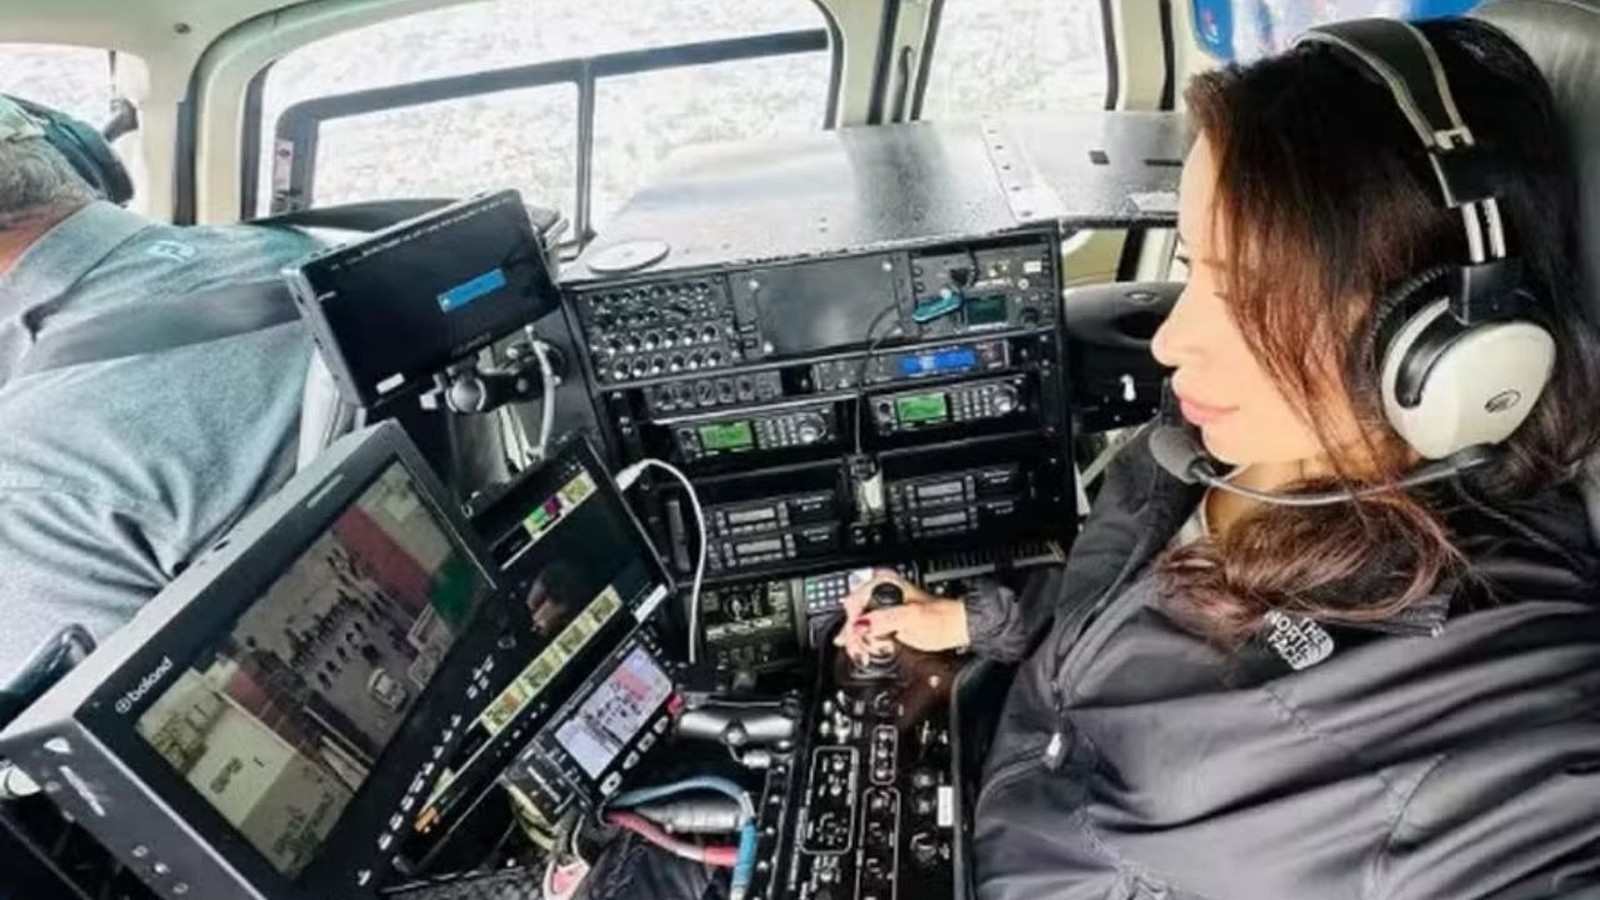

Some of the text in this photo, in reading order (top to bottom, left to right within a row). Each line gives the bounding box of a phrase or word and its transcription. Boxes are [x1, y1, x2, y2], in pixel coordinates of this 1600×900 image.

[1267, 629, 1302, 665] FACE
[1300, 617, 1327, 645] THE
[126, 655, 173, 701] boland
